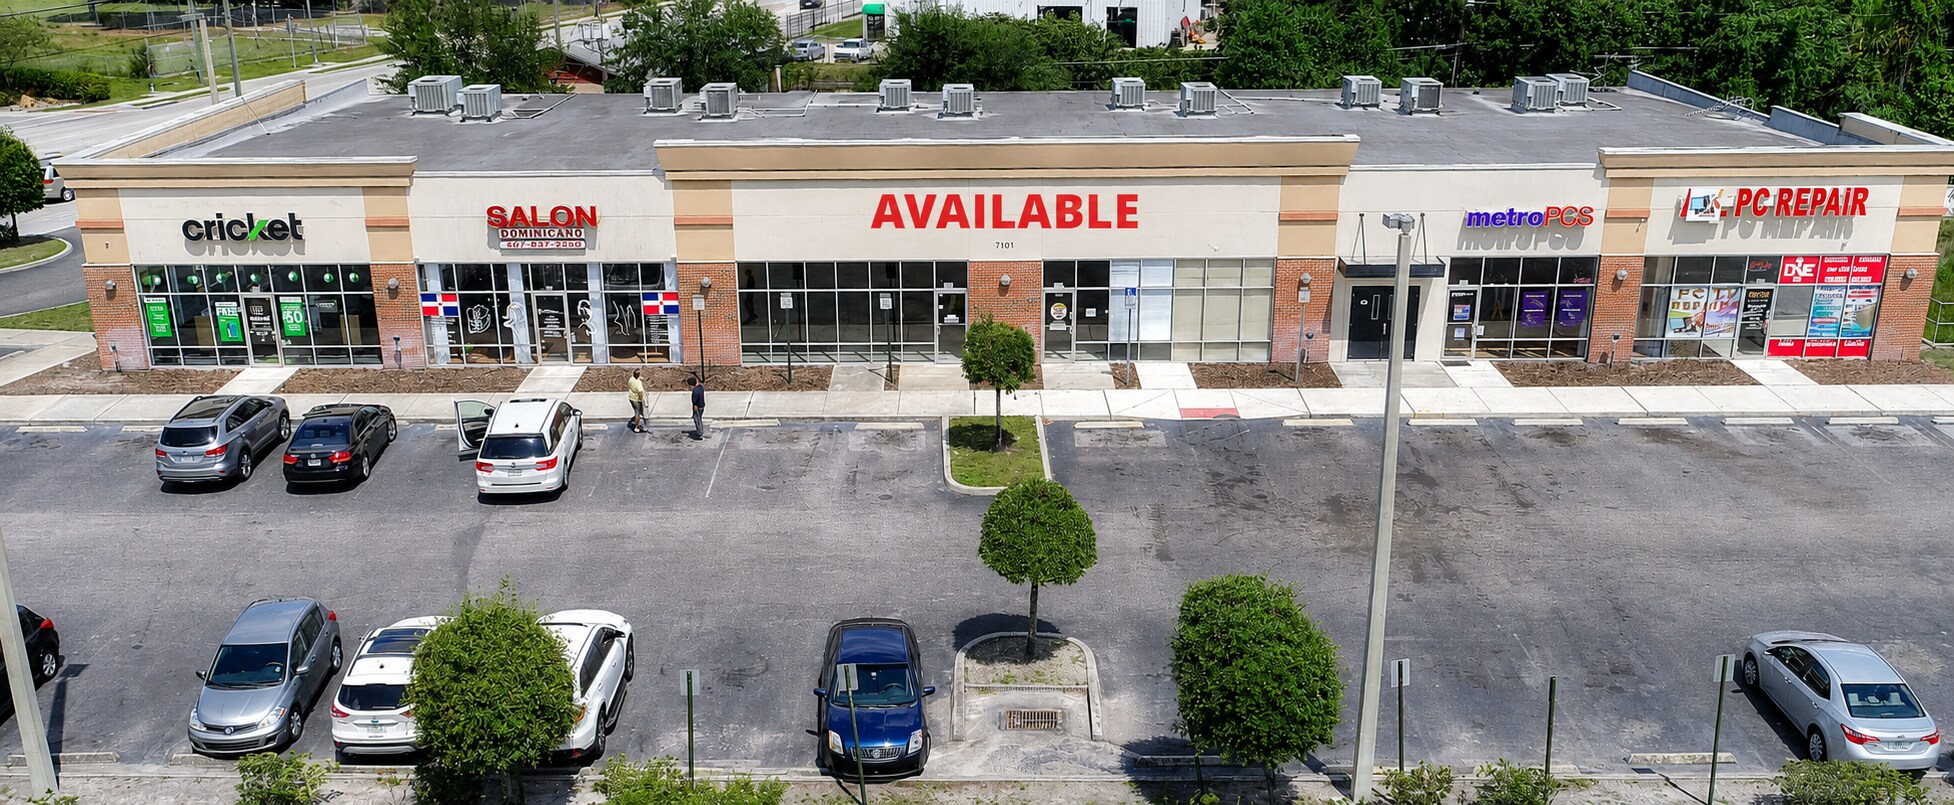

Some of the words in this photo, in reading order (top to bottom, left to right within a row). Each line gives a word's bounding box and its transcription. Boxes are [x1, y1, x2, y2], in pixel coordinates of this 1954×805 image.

[870, 193, 1139, 230] AVAILABLE
[1734, 187, 1770, 217] PC
[182, 212, 303, 241] cricket
[486, 205, 598, 228] SALON
[1466, 205, 1594, 228] metroPCS
[501, 229, 583, 238] DOMINICANO
